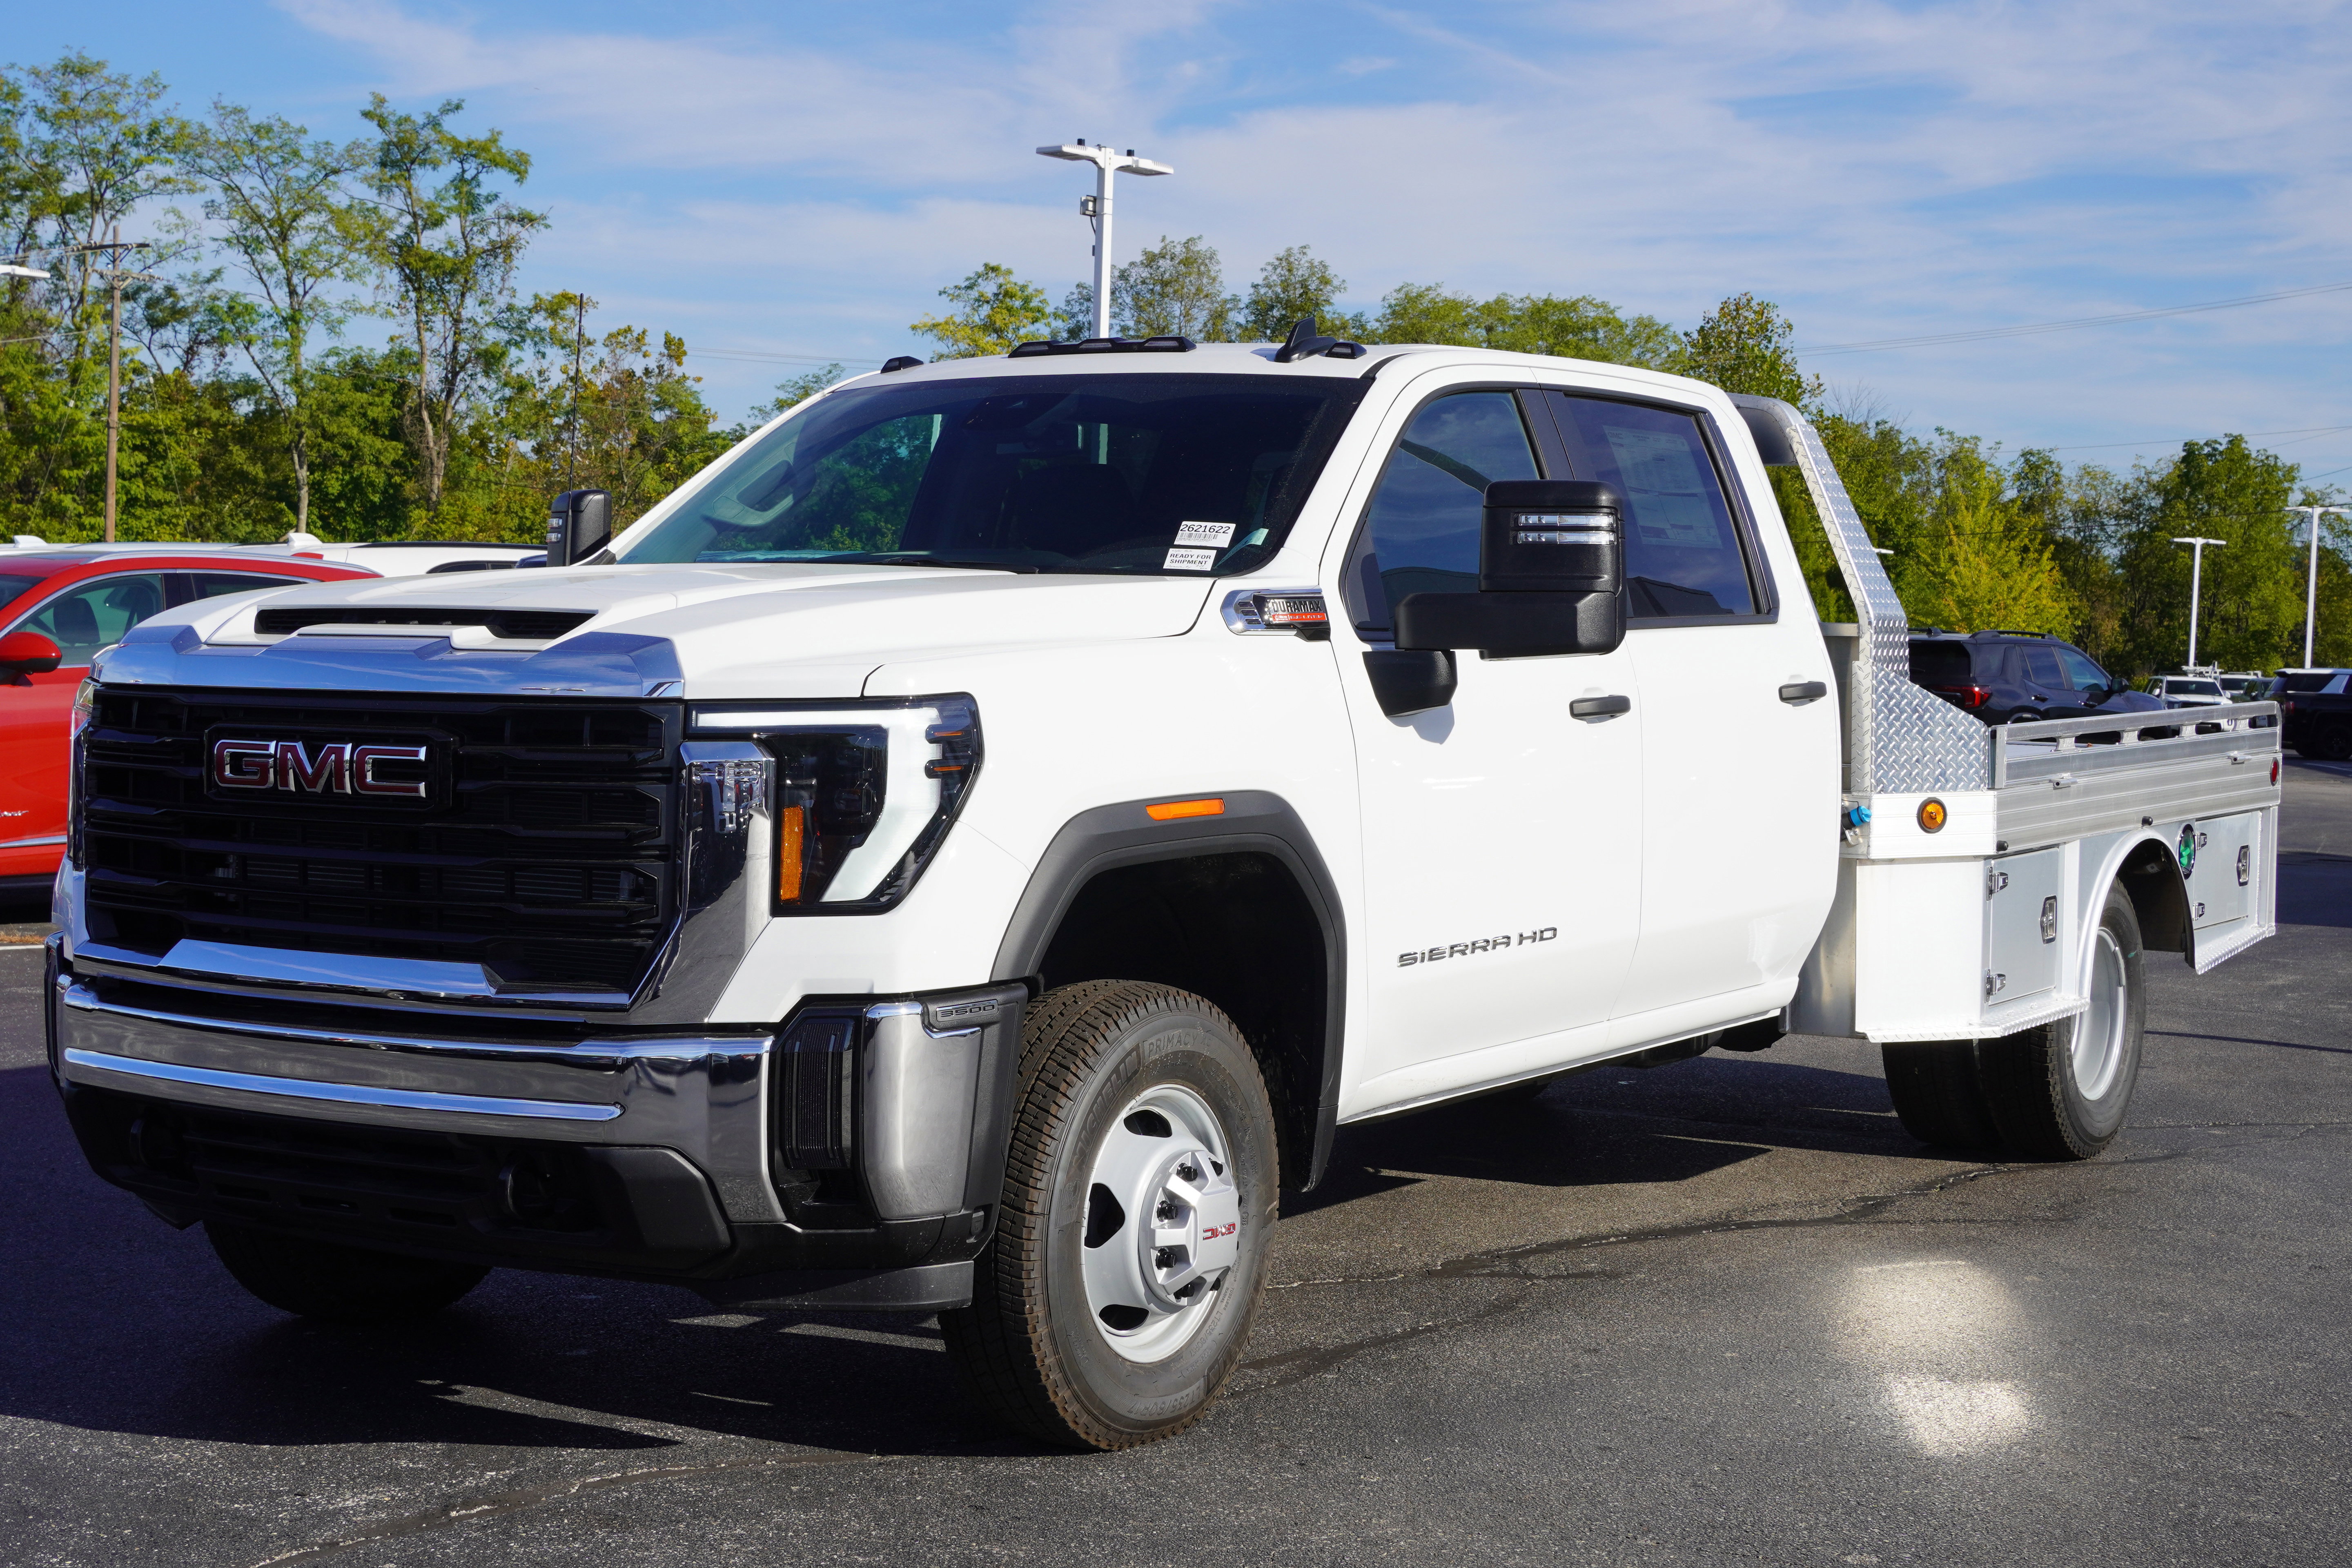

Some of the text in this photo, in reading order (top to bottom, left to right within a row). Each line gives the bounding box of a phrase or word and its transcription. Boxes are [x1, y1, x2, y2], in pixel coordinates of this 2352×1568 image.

[1180, 524, 1231, 534] 2621622
[1272, 600, 1323, 613] DURAMAX
[214, 739, 427, 798] GMC
[1396, 927, 1557, 968] SIERRA HD
[940, 1004, 996, 1017] 3500
[1148, 1031, 1198, 1056] PRIMACY
[1073, 1050, 1138, 1169] MICHELIN
[1203, 1222, 1236, 1241] GMC
